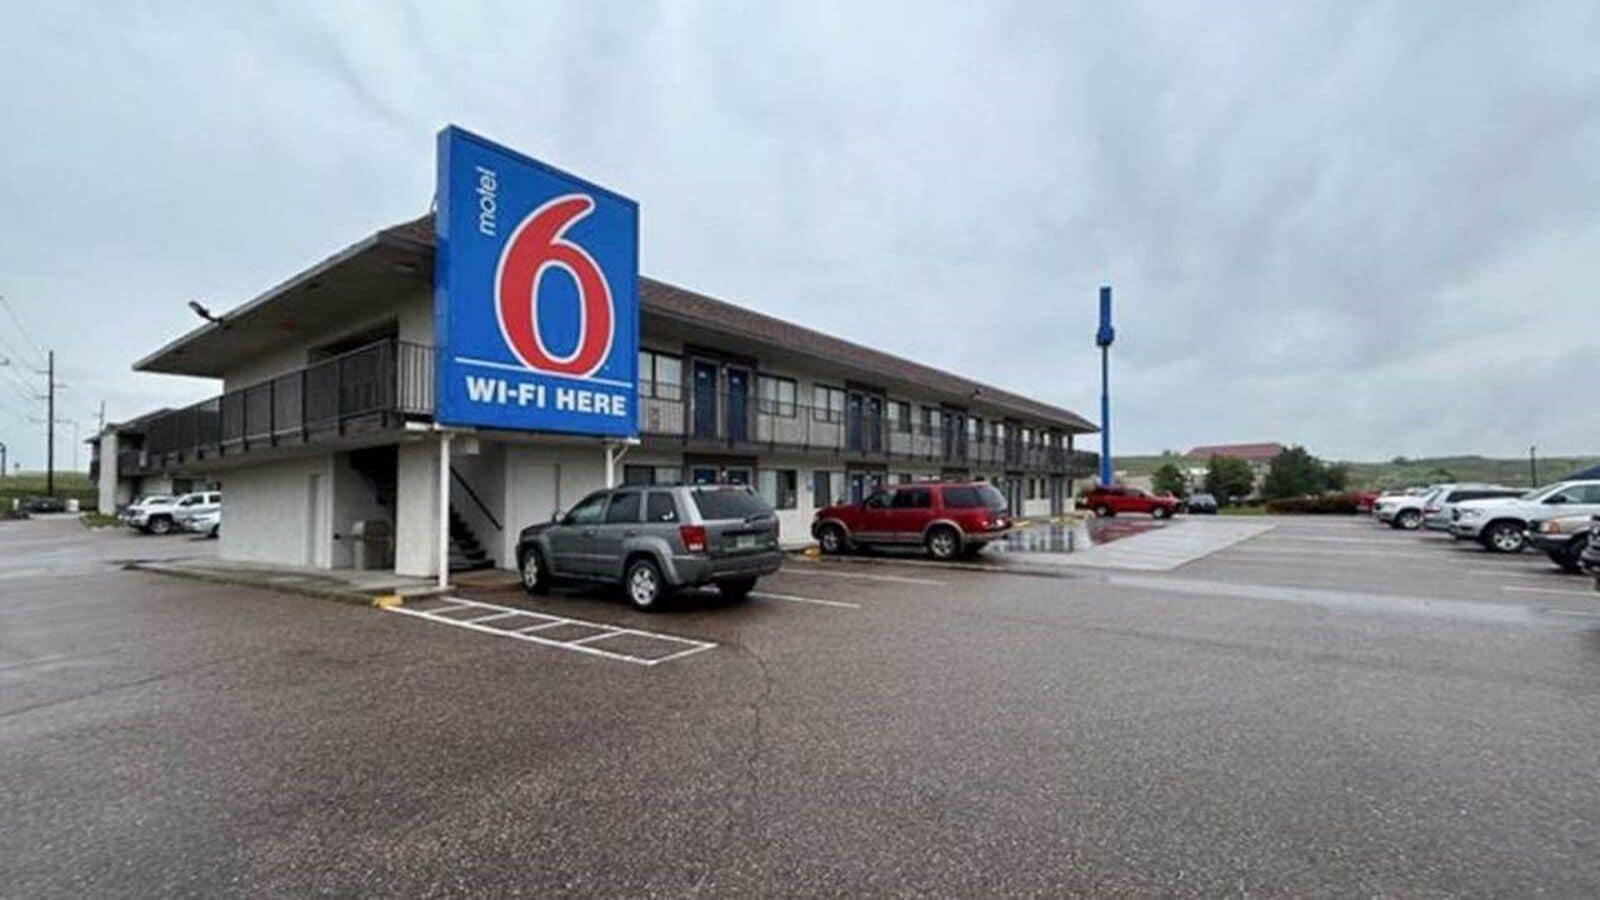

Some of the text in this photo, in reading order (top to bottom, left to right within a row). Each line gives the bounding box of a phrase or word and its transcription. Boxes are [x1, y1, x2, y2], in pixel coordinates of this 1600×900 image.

[477, 167, 497, 236] motel
[495, 194, 615, 378] 6
[466, 377, 627, 416] WI-FI HERE
